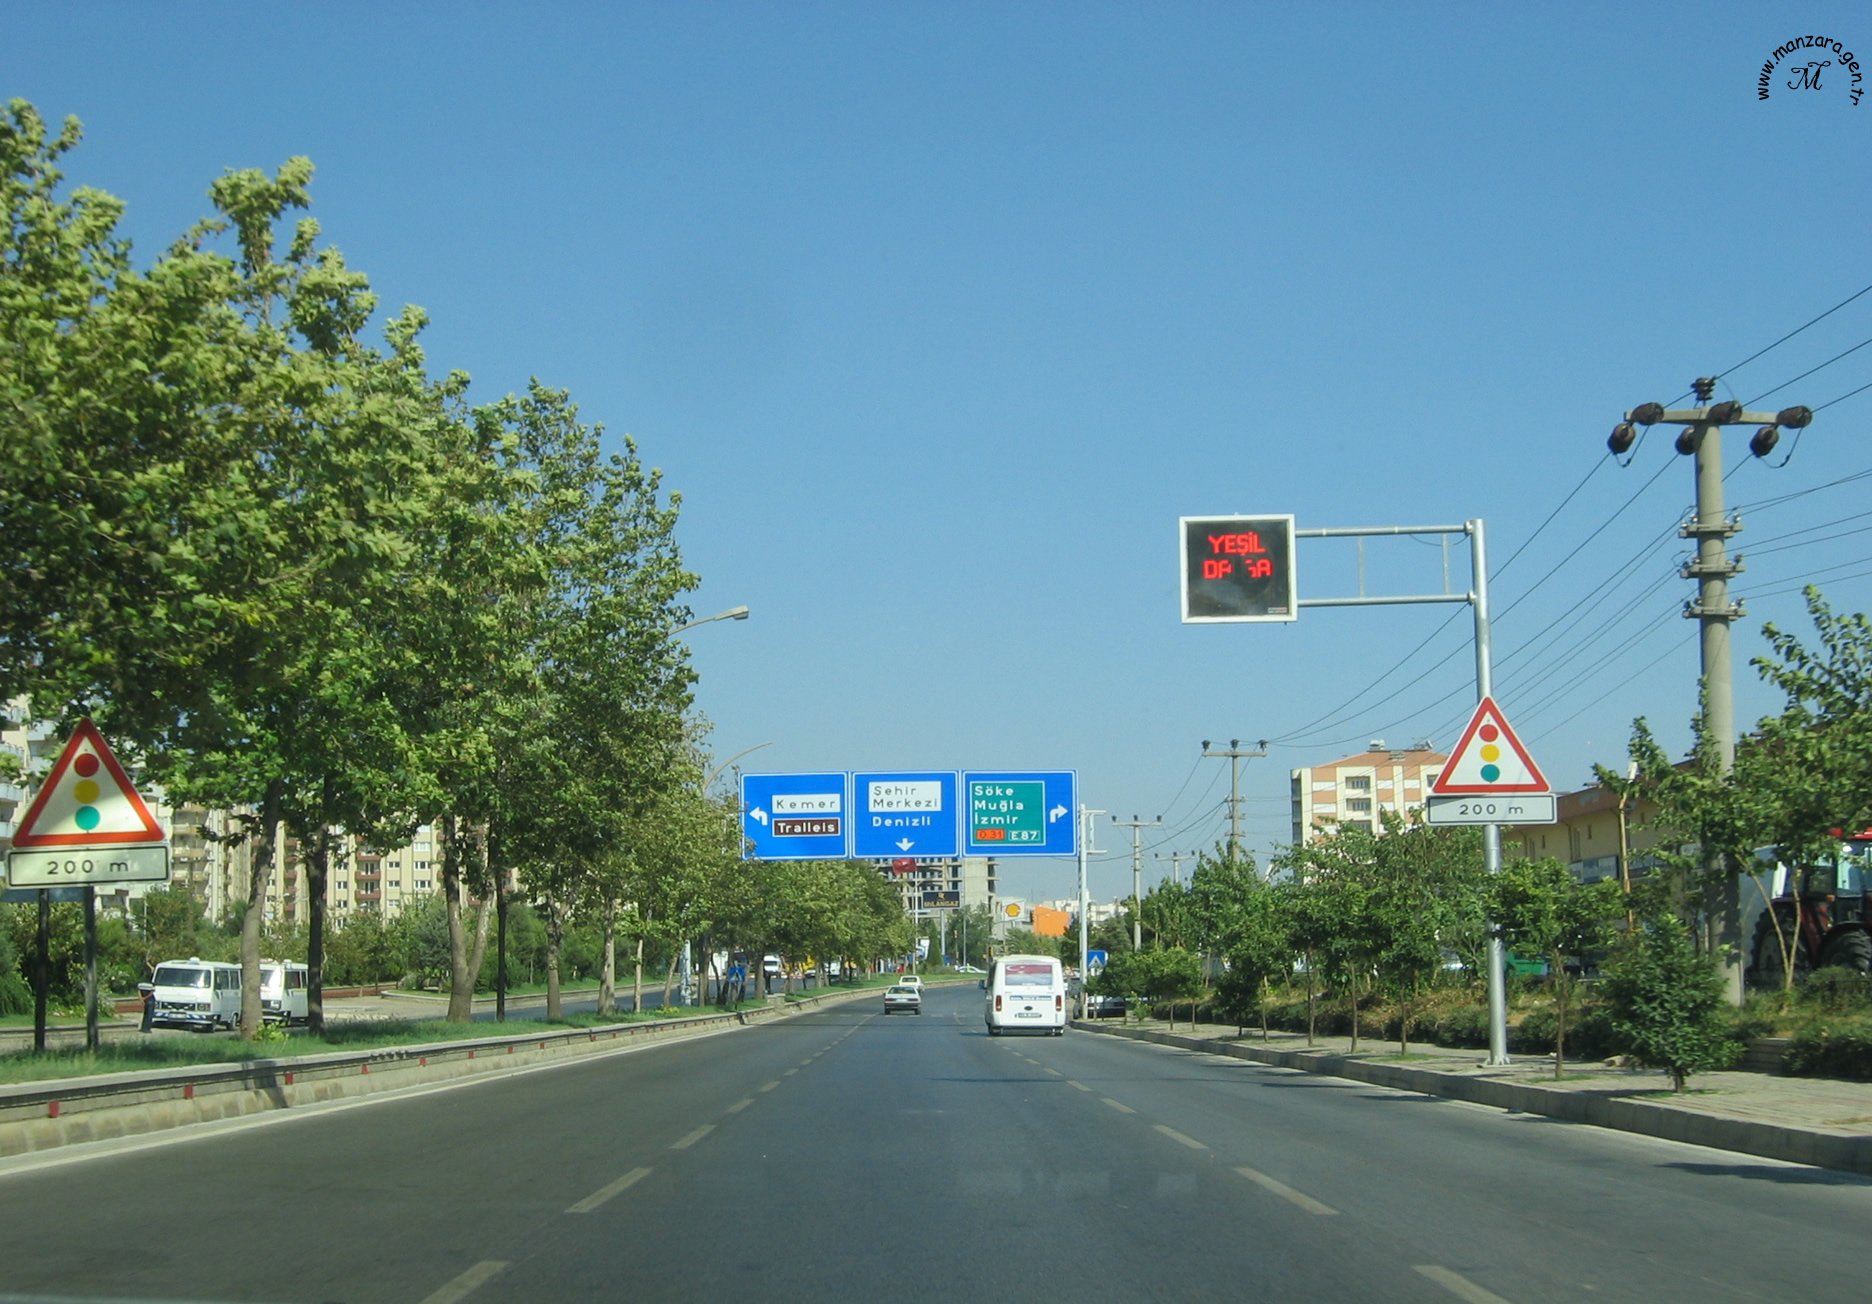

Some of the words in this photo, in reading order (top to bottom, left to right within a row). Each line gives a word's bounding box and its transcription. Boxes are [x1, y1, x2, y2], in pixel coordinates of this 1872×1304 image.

[974, 785, 1014, 796] Söke
[776, 798, 836, 810] Kemer
[872, 797, 938, 809] Merkezi
[974, 799, 1024, 813] Muğla
[1459, 803, 1497, 815] 200
[1508, 806, 1524, 815] m
[777, 821, 835, 833] Tralleis
[872, 815, 931, 827] Denizli
[47, 859, 94, 875] 200
[109, 861, 129, 873] m
